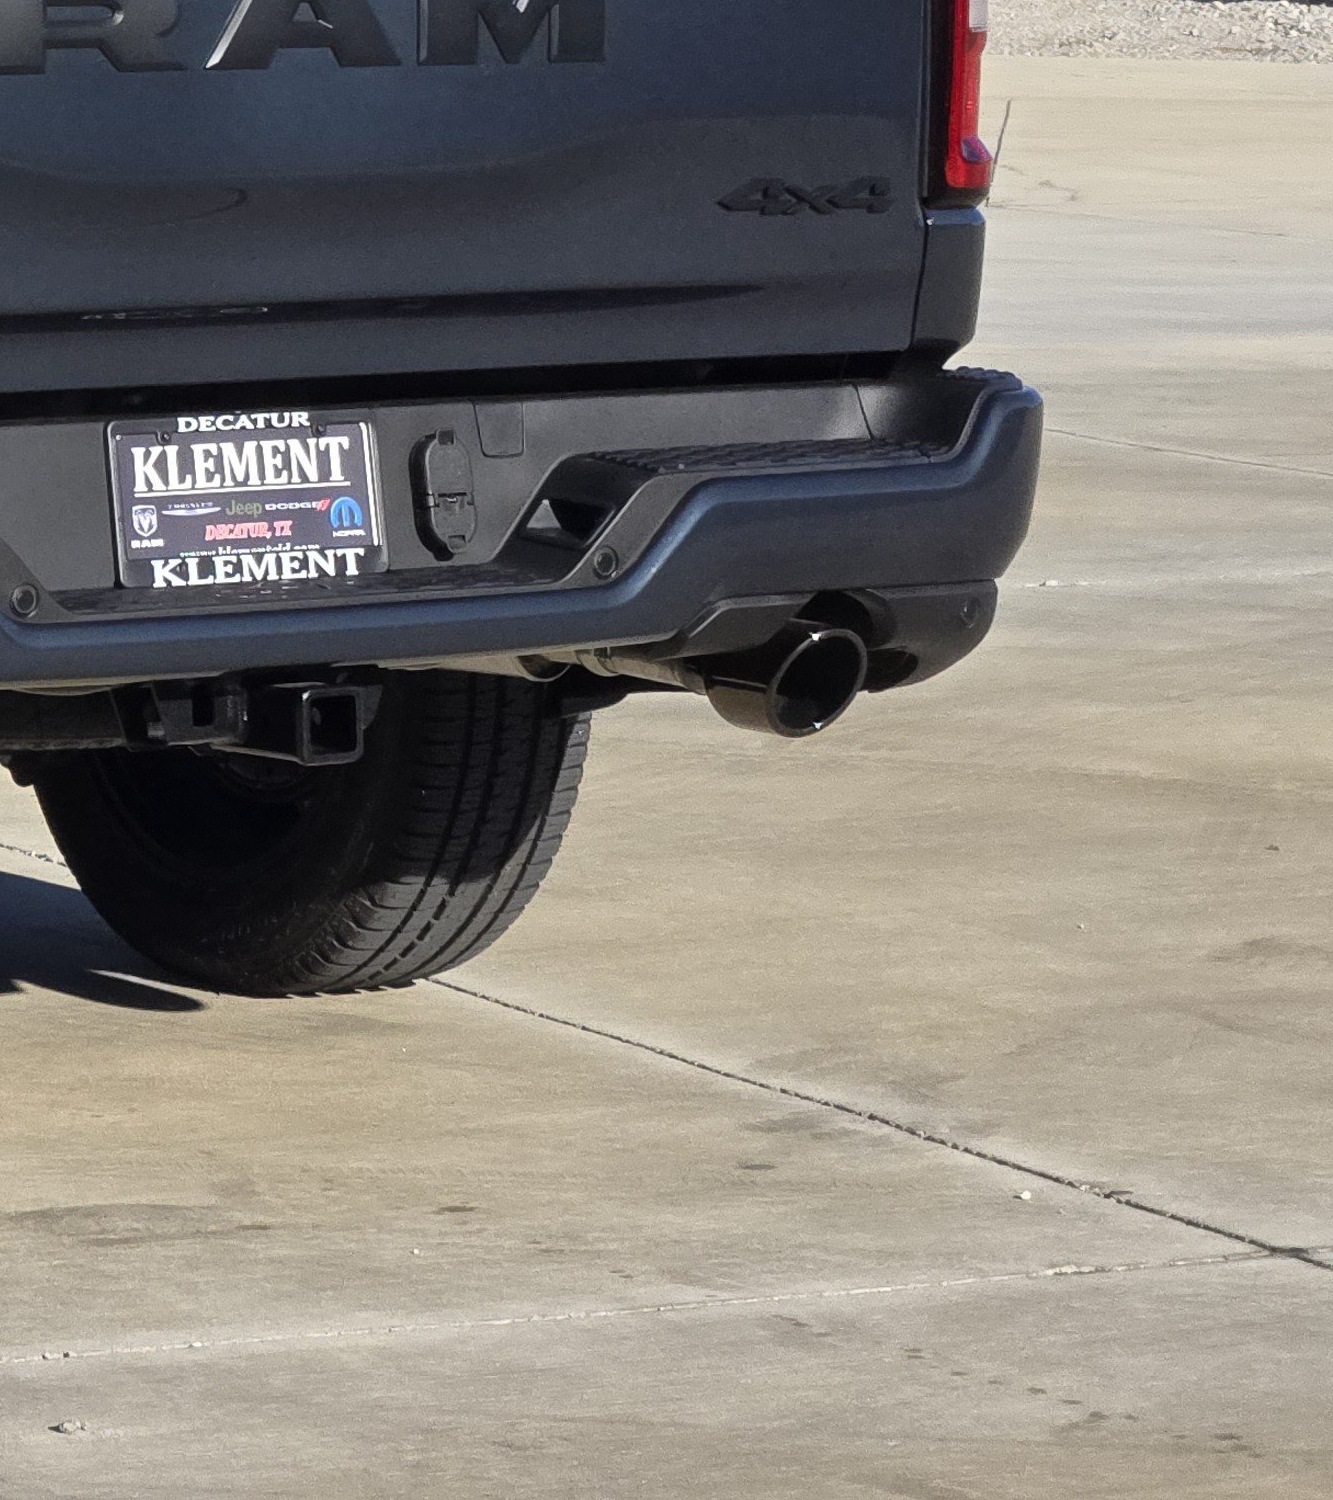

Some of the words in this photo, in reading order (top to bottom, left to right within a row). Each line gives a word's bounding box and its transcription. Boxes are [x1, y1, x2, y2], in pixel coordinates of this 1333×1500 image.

[177, 411, 311, 434] DECATUR
[131, 436, 350, 492] KLEMENT
[225, 499, 263, 519] Jeep
[273, 520, 293, 537] TX
[150, 547, 365, 589] KLEMENT
